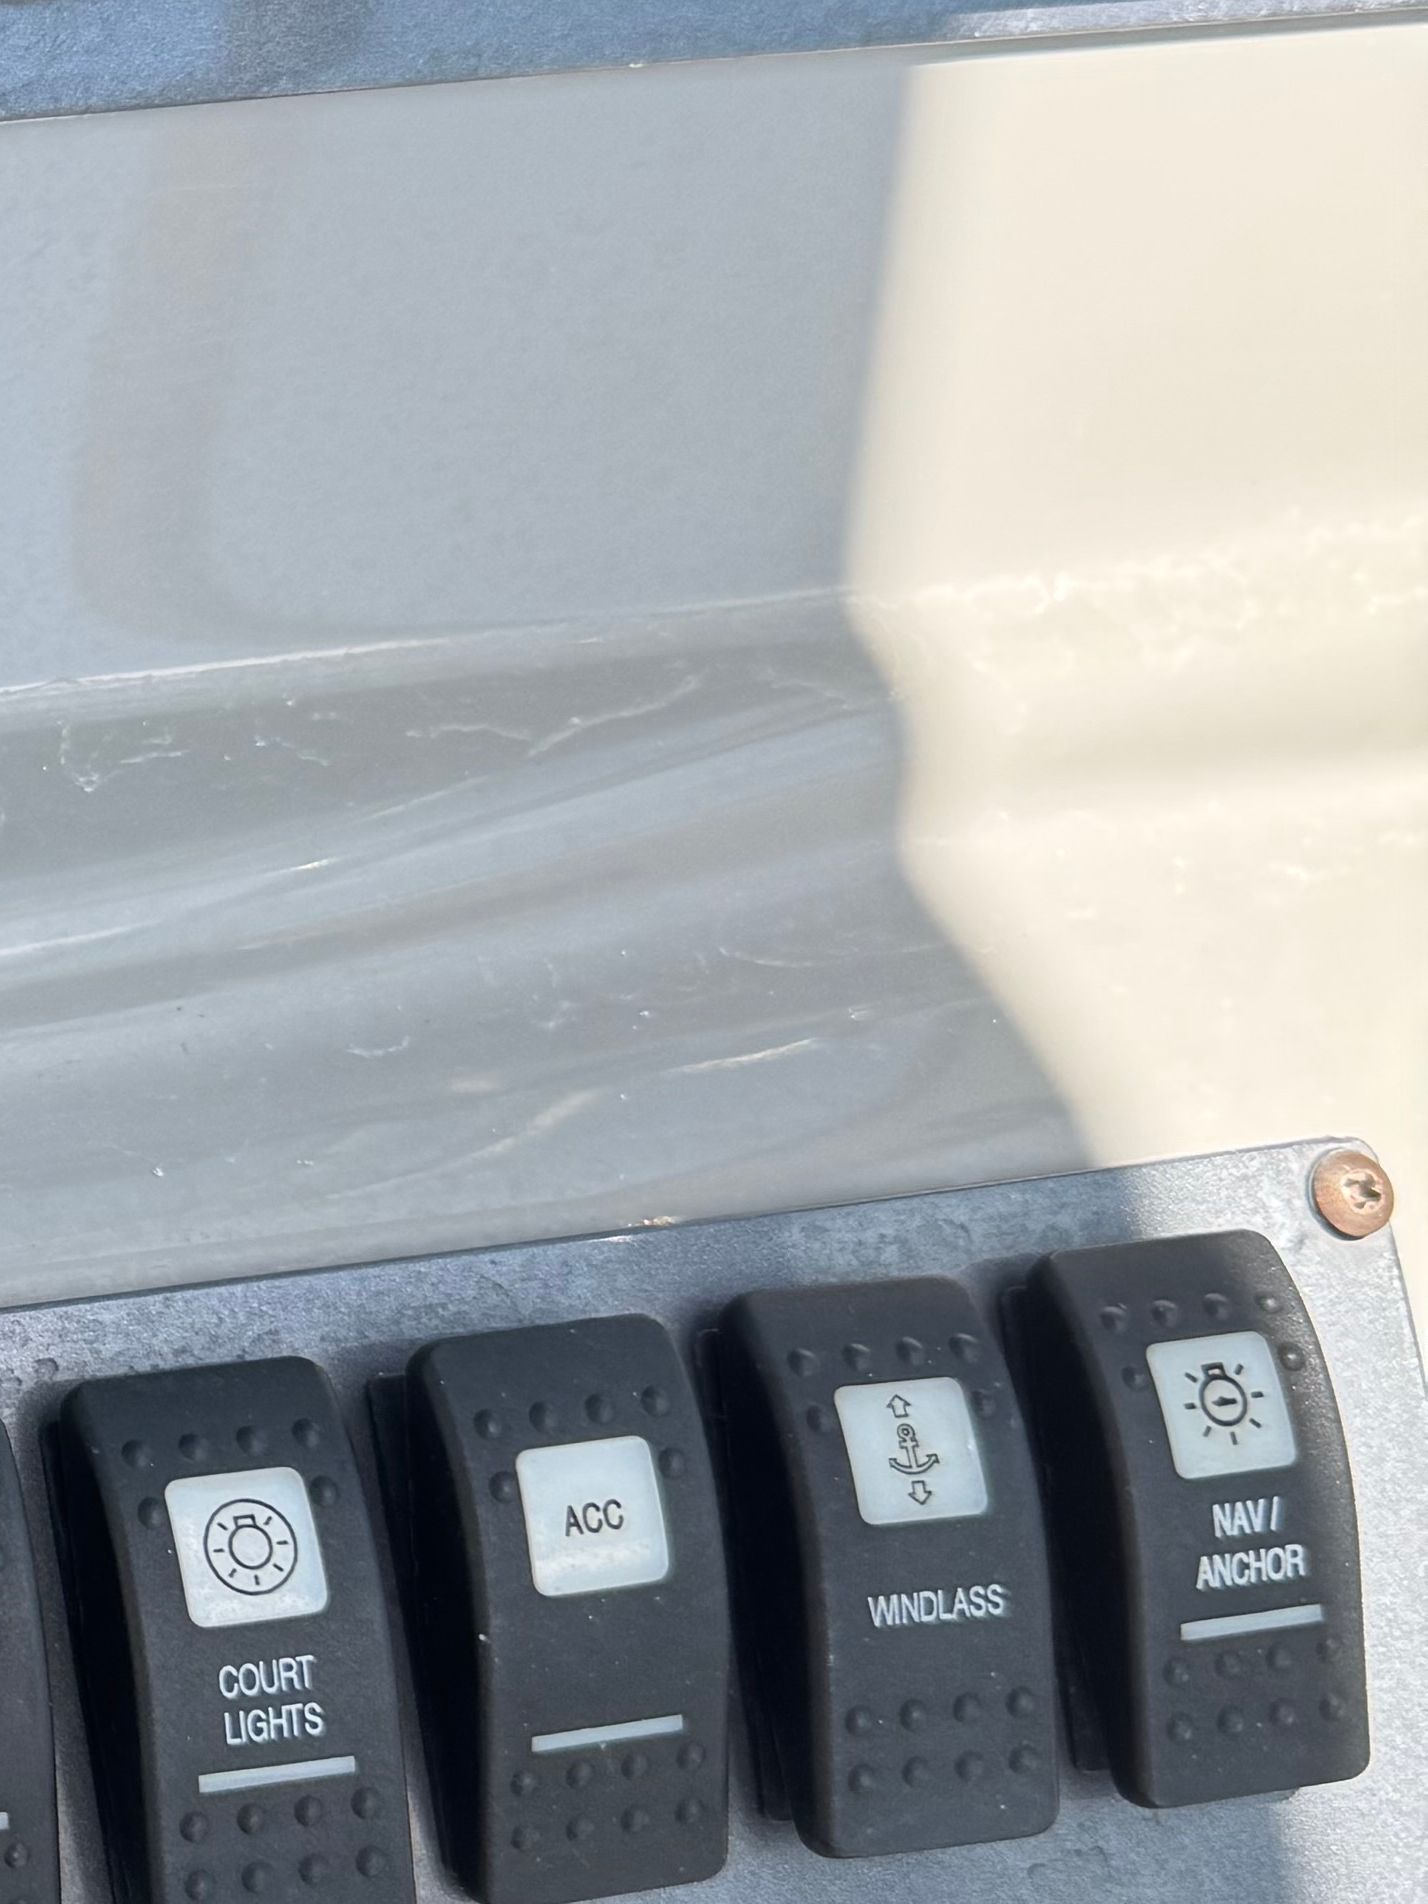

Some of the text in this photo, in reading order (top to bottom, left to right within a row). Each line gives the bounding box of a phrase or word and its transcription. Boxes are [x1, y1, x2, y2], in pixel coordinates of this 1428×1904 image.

[564, 1499, 625, 1537] ACC
[1197, 1544, 1306, 1589] ANCHOR
[868, 1584, 1004, 1627] WINDLASS
[219, 1655, 314, 1698] COURT
[224, 1703, 323, 1744] LIGHTS
